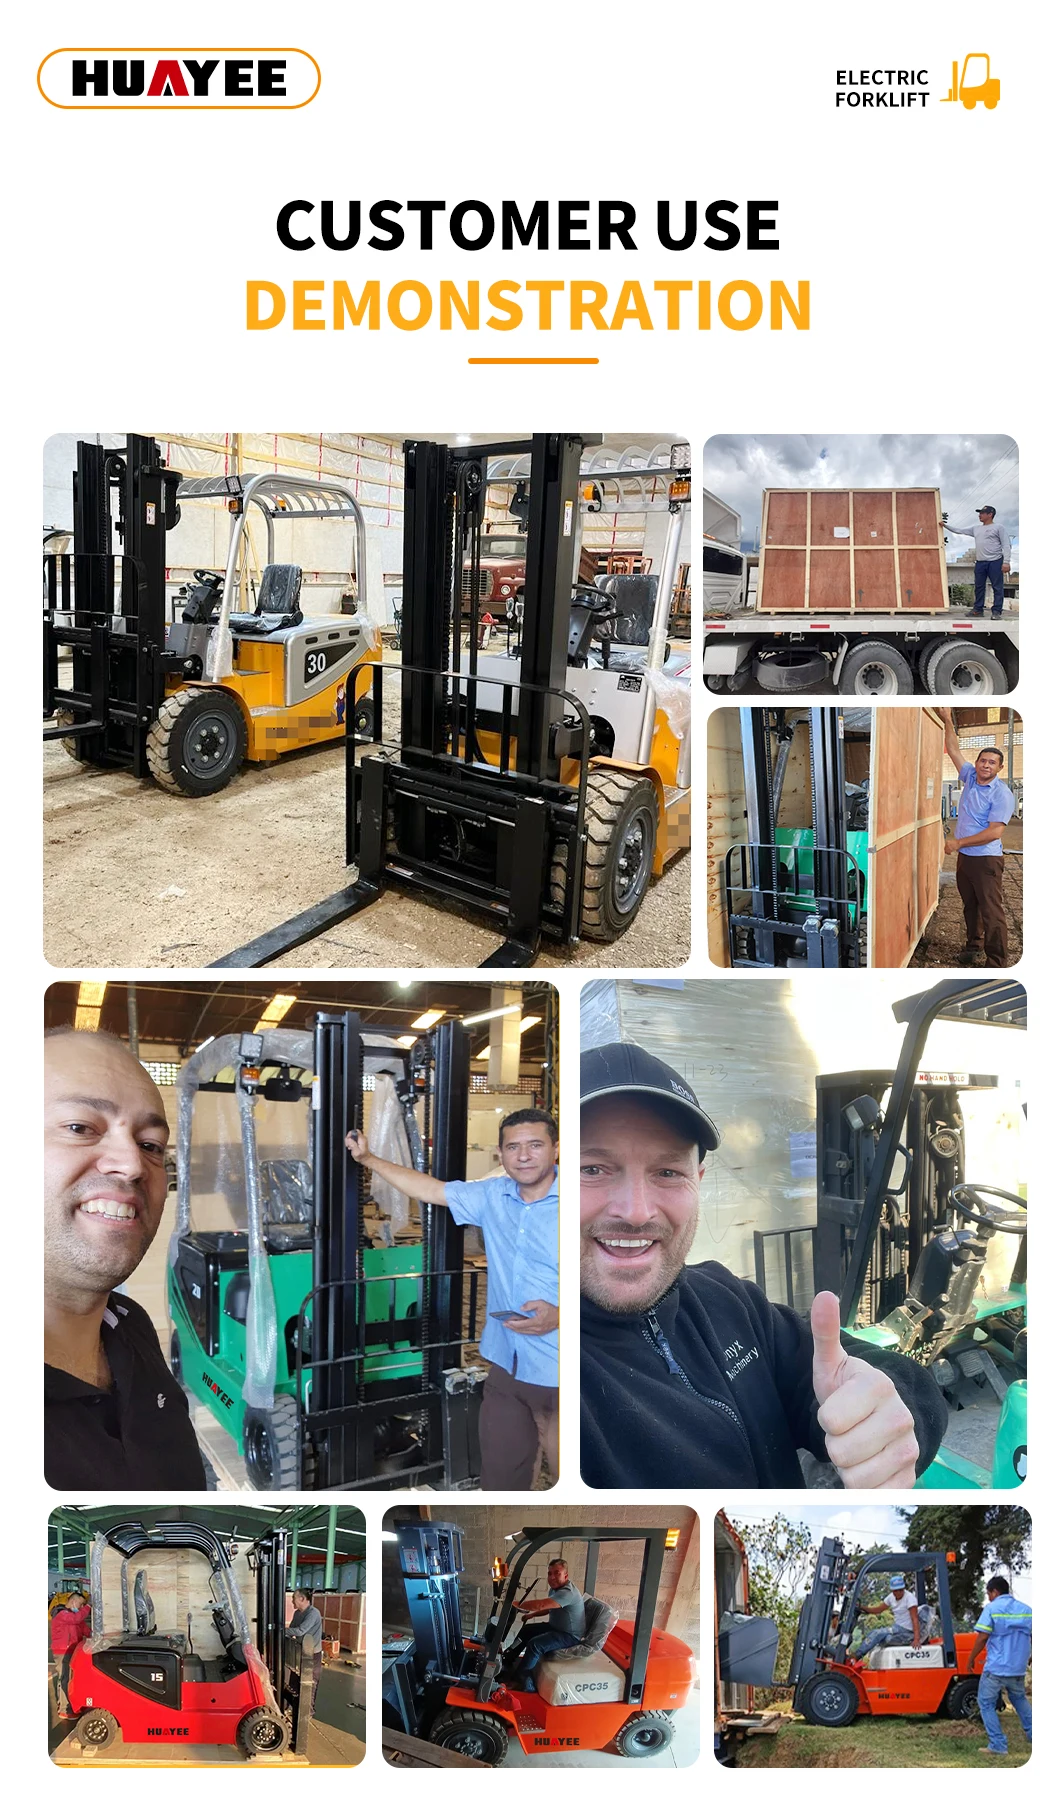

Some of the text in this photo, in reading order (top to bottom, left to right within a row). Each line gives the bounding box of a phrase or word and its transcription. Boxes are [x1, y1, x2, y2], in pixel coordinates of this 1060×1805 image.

[307, 652, 326, 674] 30
[192, 1282, 201, 1299] 20
[202, 1371, 234, 1409] HUAYEE
[904, 1651, 930, 1659] CPC35
[150, 1672, 164, 1682] 15
[574, 1682, 609, 1693] CPC35
[147, 1727, 190, 1736] HUAYEE
[534, 1737, 580, 1746] HUAYEE
